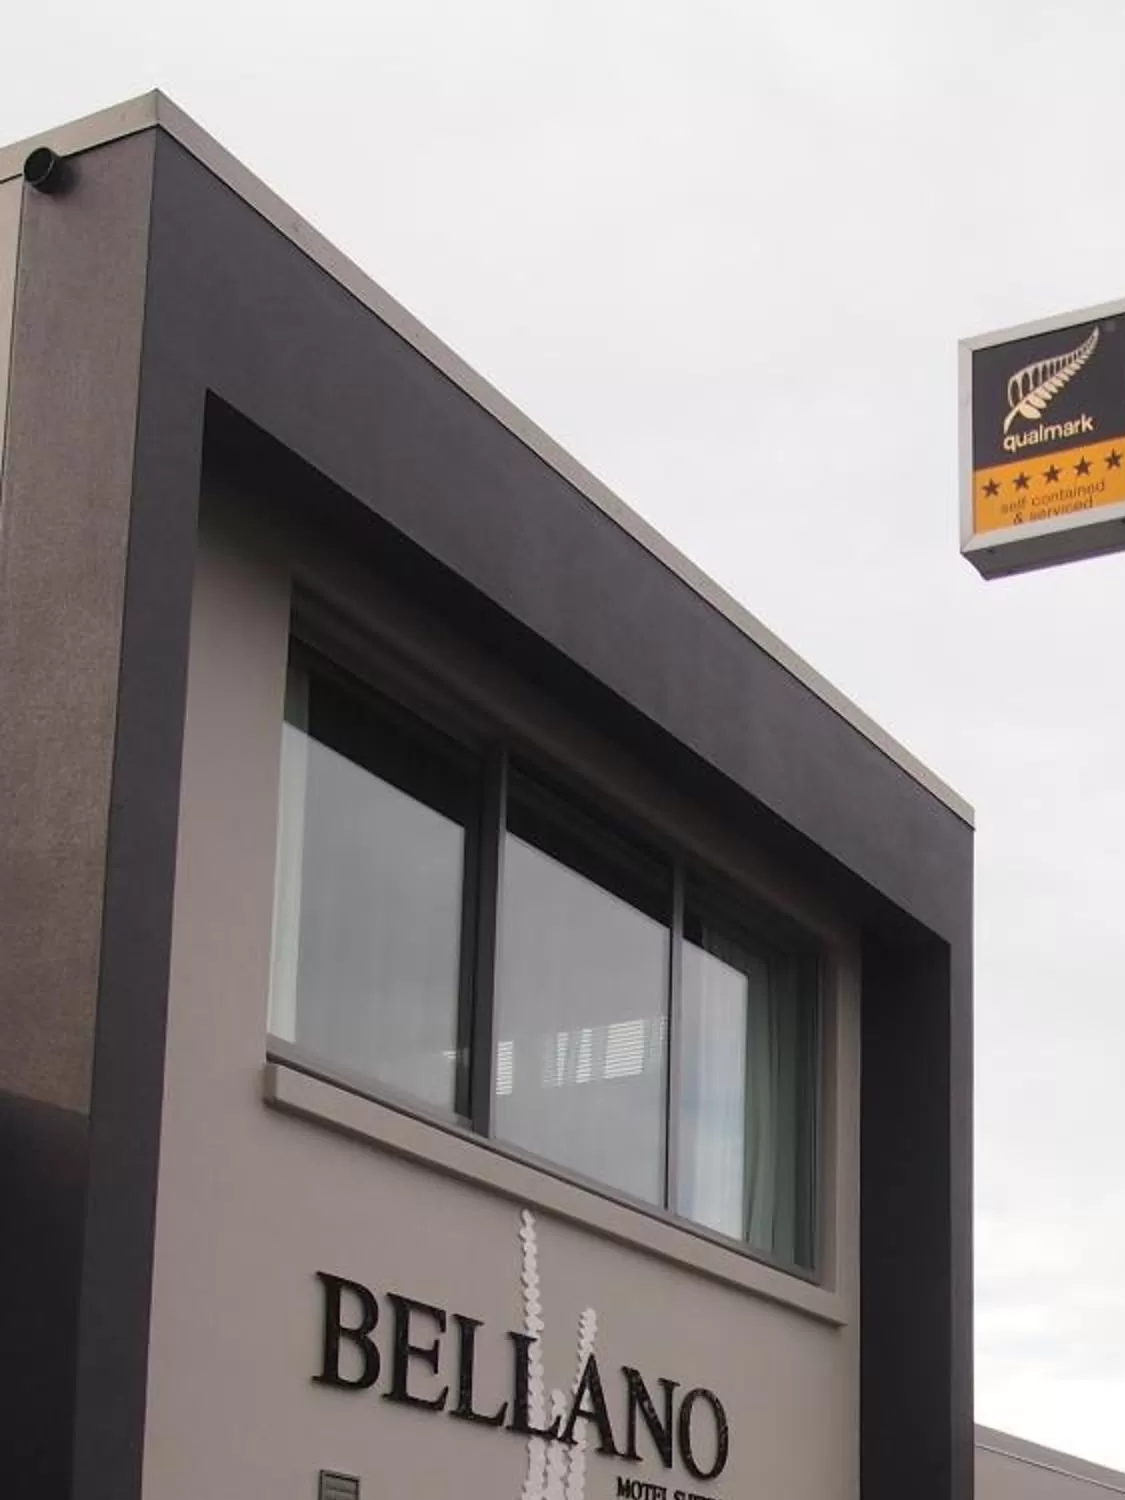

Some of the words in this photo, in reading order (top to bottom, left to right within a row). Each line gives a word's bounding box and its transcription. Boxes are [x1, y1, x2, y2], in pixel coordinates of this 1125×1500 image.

[1002, 413, 1095, 453] qualmark
[1029, 496, 1095, 521] serviced
[1030, 479, 1106, 507] contained
[311, 1270, 729, 1481] BELLANO
